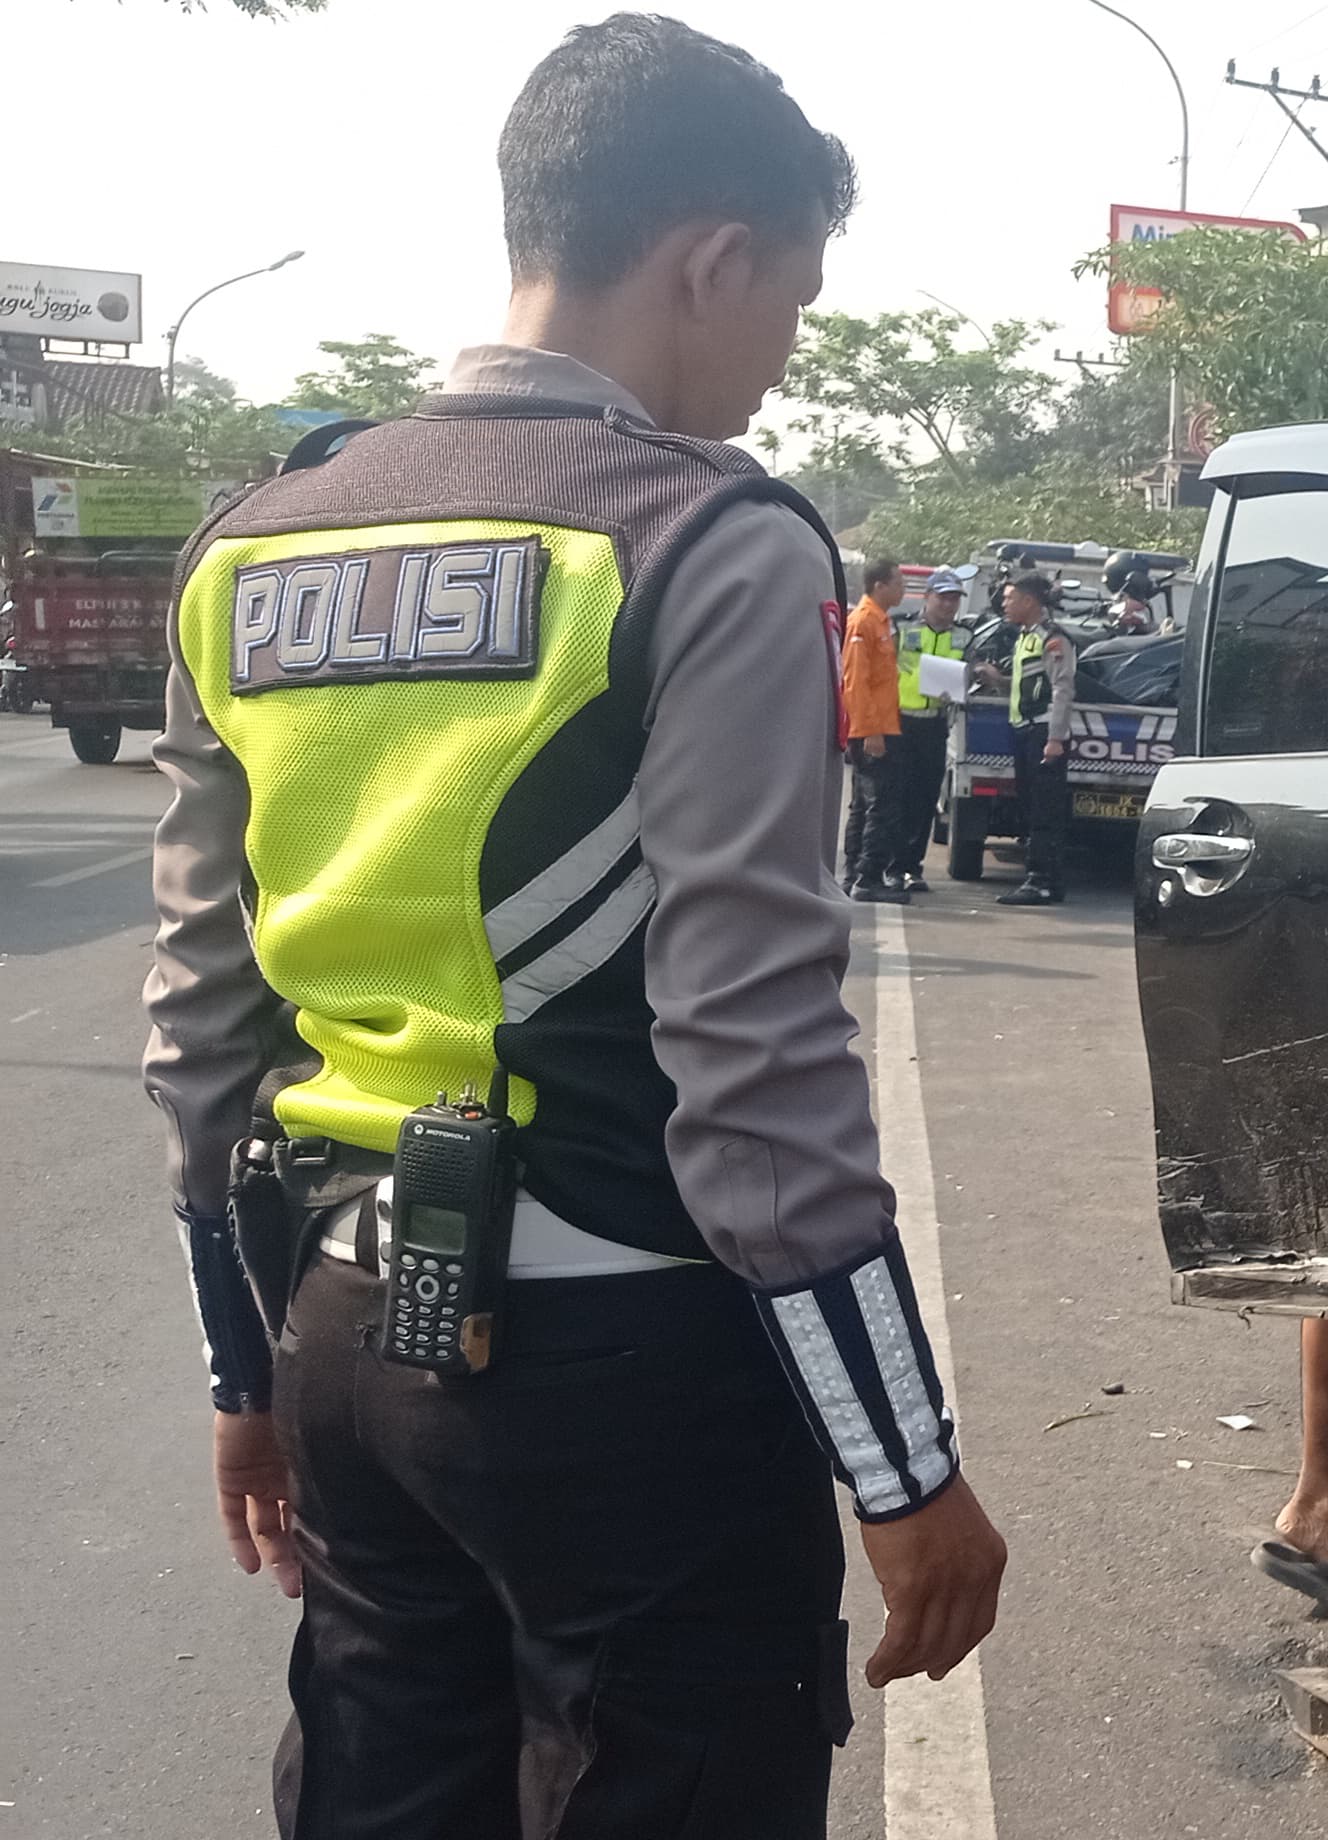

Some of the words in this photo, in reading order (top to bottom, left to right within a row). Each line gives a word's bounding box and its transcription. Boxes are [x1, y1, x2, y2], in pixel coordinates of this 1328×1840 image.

[29, 296, 93, 322] jogja
[233, 546, 528, 682] POLISI
[426, 1128, 471, 1141] MOTOROLA
